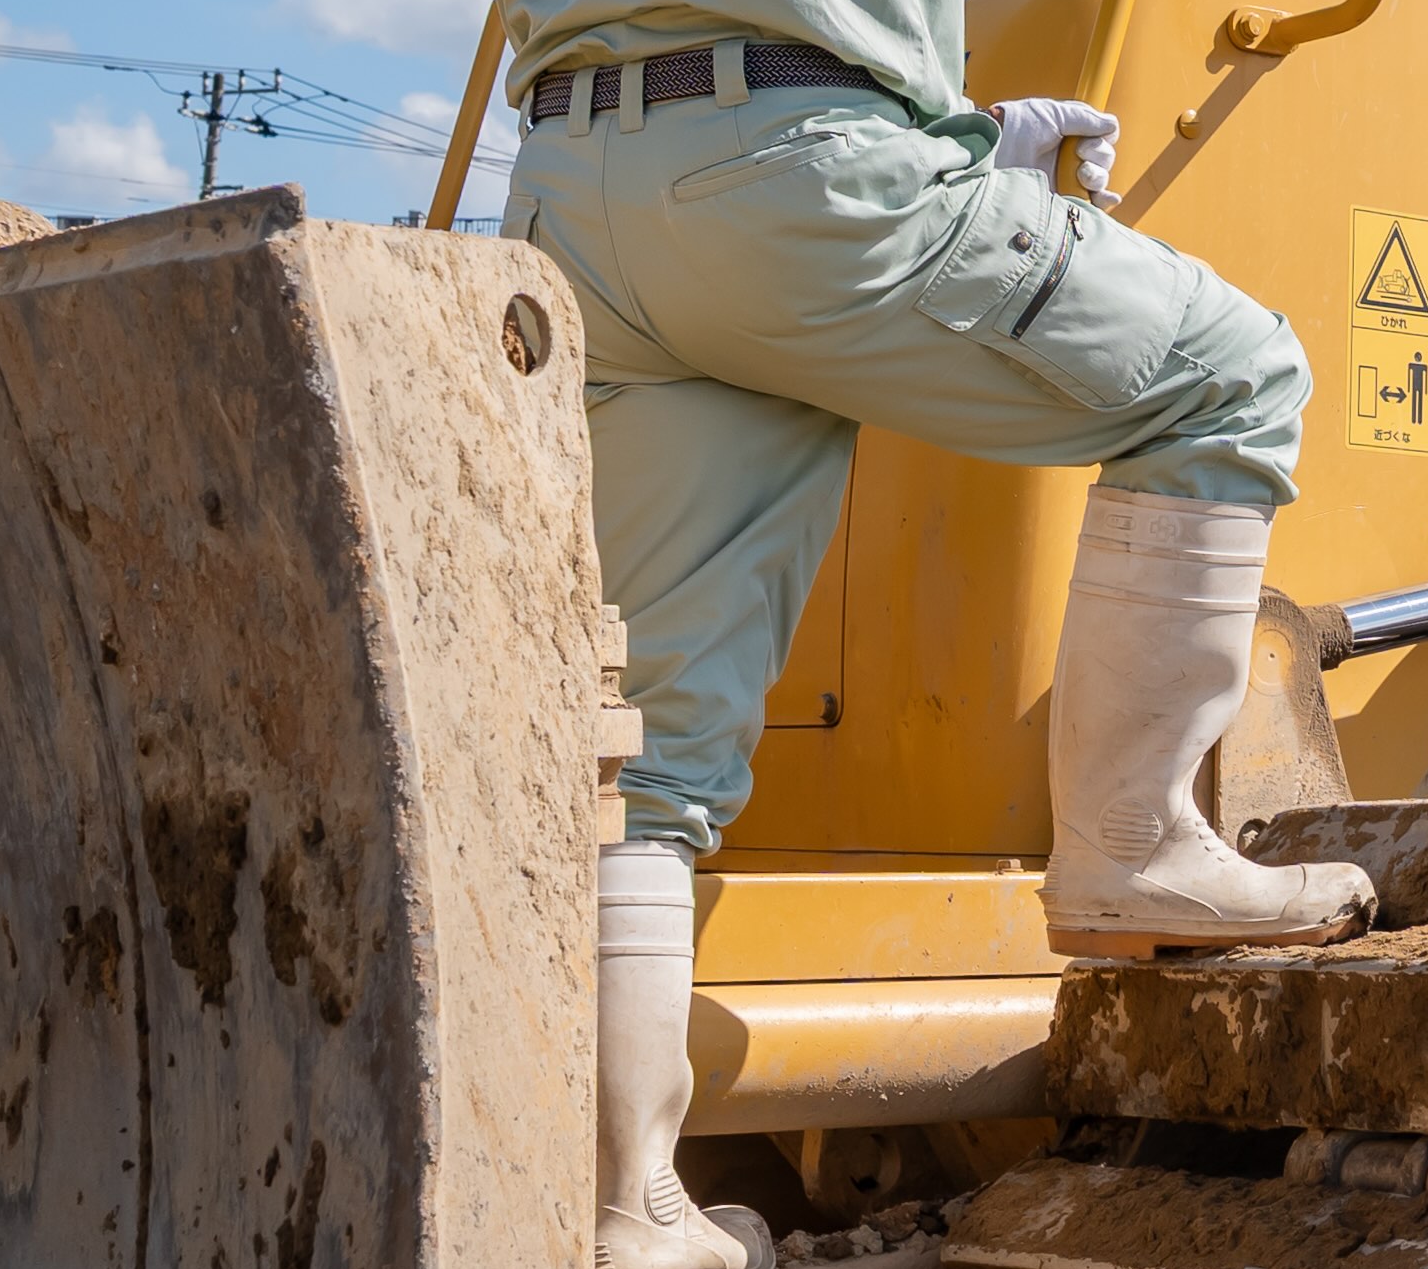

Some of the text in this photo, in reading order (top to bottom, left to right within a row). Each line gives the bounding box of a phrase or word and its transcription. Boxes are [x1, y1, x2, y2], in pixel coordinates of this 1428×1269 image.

[1380, 315, 1408, 329] ひかれ
[1373, 428, 1412, 443] 近づくな
